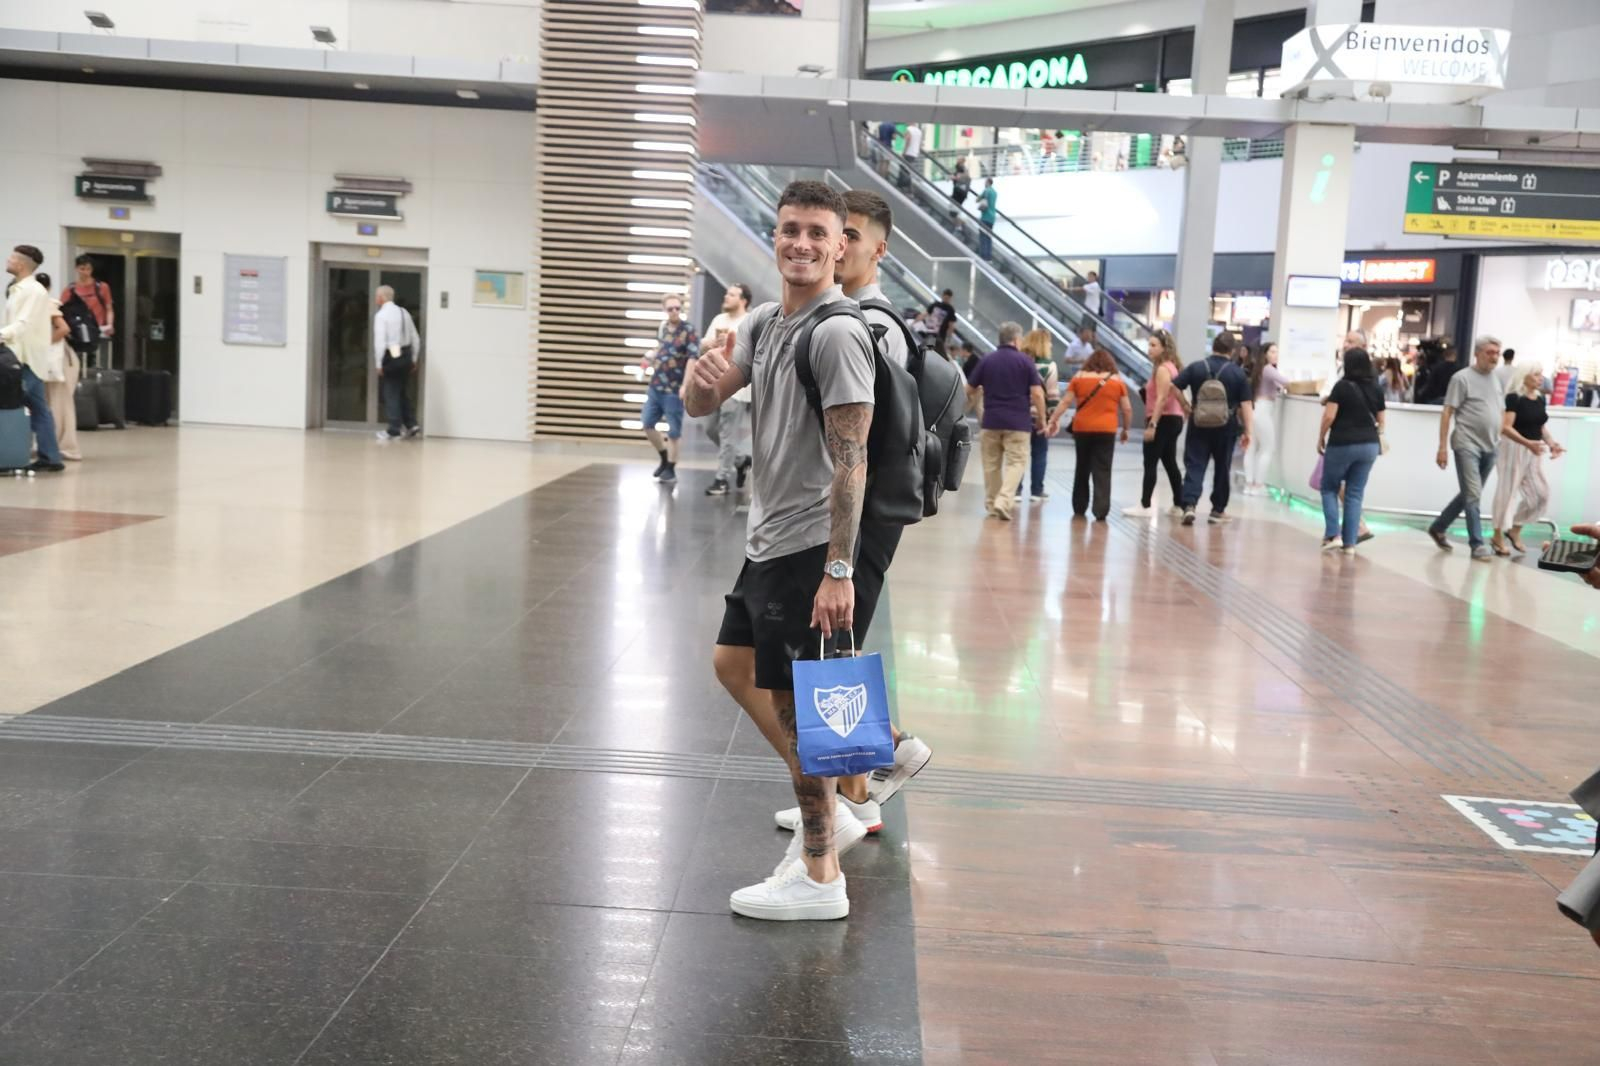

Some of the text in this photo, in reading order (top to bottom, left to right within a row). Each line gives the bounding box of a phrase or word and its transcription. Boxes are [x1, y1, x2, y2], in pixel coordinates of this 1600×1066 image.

[1345, 31, 1490, 55] Bienvenidos
[1403, 58, 1488, 78] WELCOME
[1438, 169, 1450, 187] P
[1456, 170, 1519, 183] Aparcamiento
[1456, 195, 1497, 206] Sala Club
